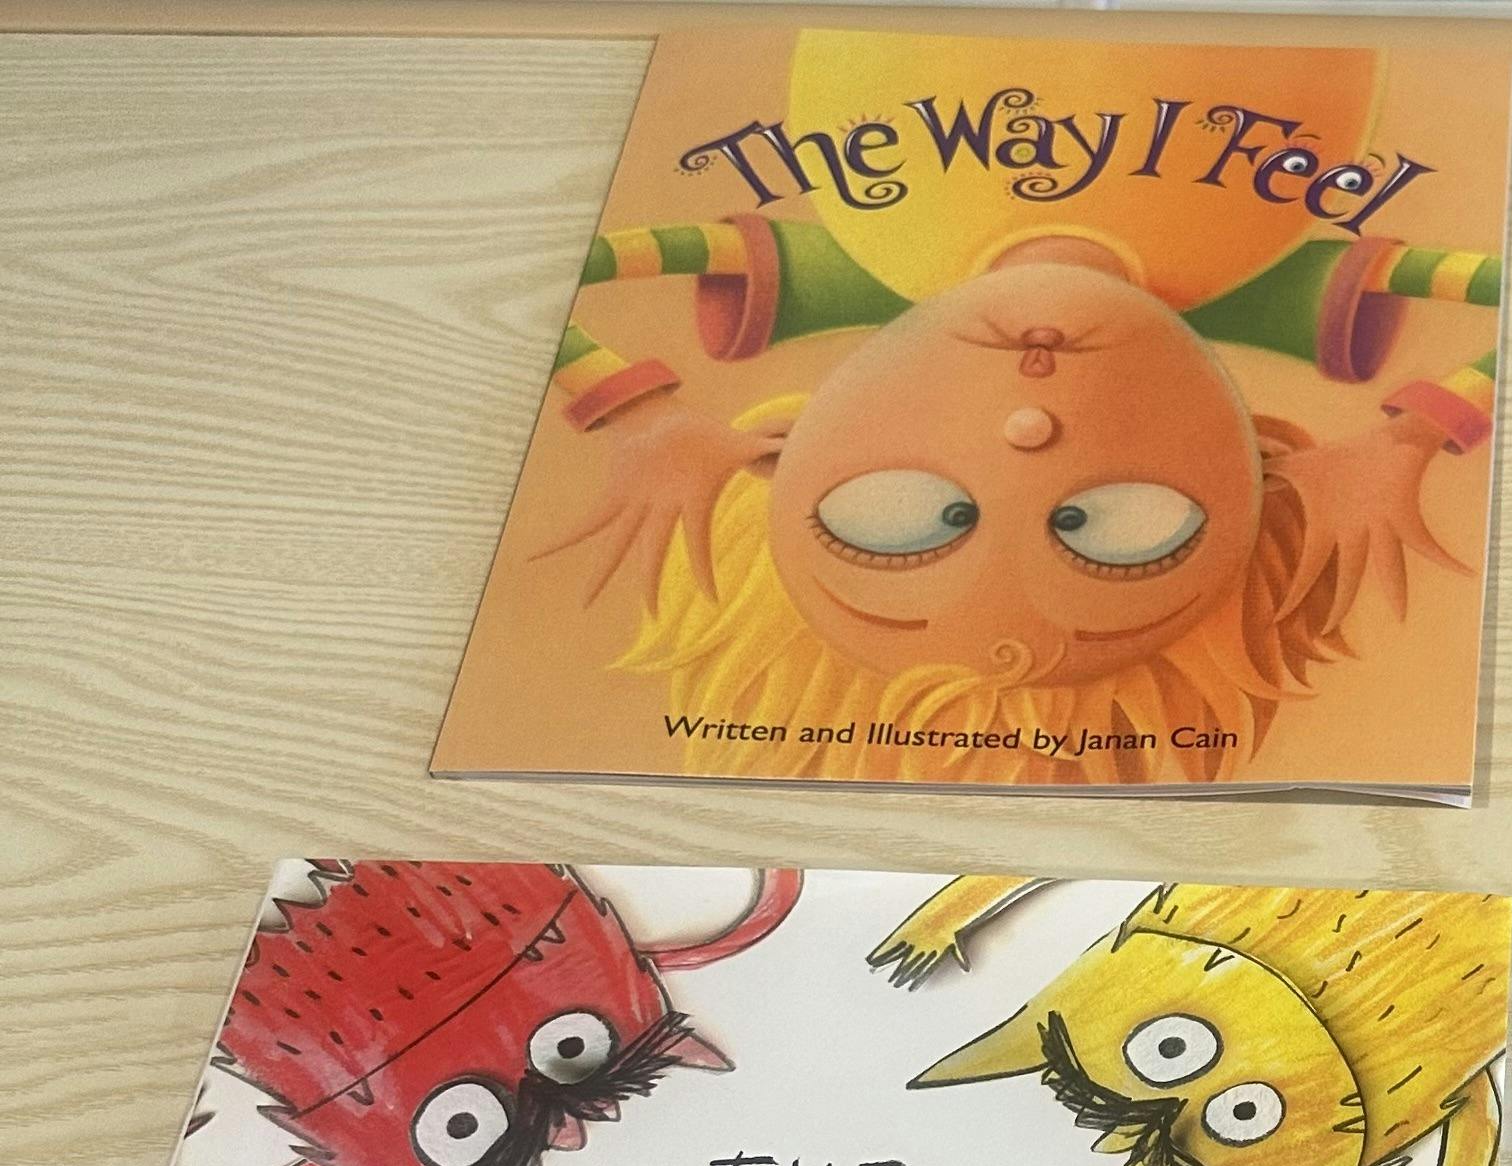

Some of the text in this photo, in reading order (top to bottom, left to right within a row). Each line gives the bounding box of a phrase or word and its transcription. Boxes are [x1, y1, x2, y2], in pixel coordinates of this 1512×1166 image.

[680, 87, 1437, 235] The Way I Feel
[663, 715, 1239, 756] Written and Illustrated by Janan Cain
